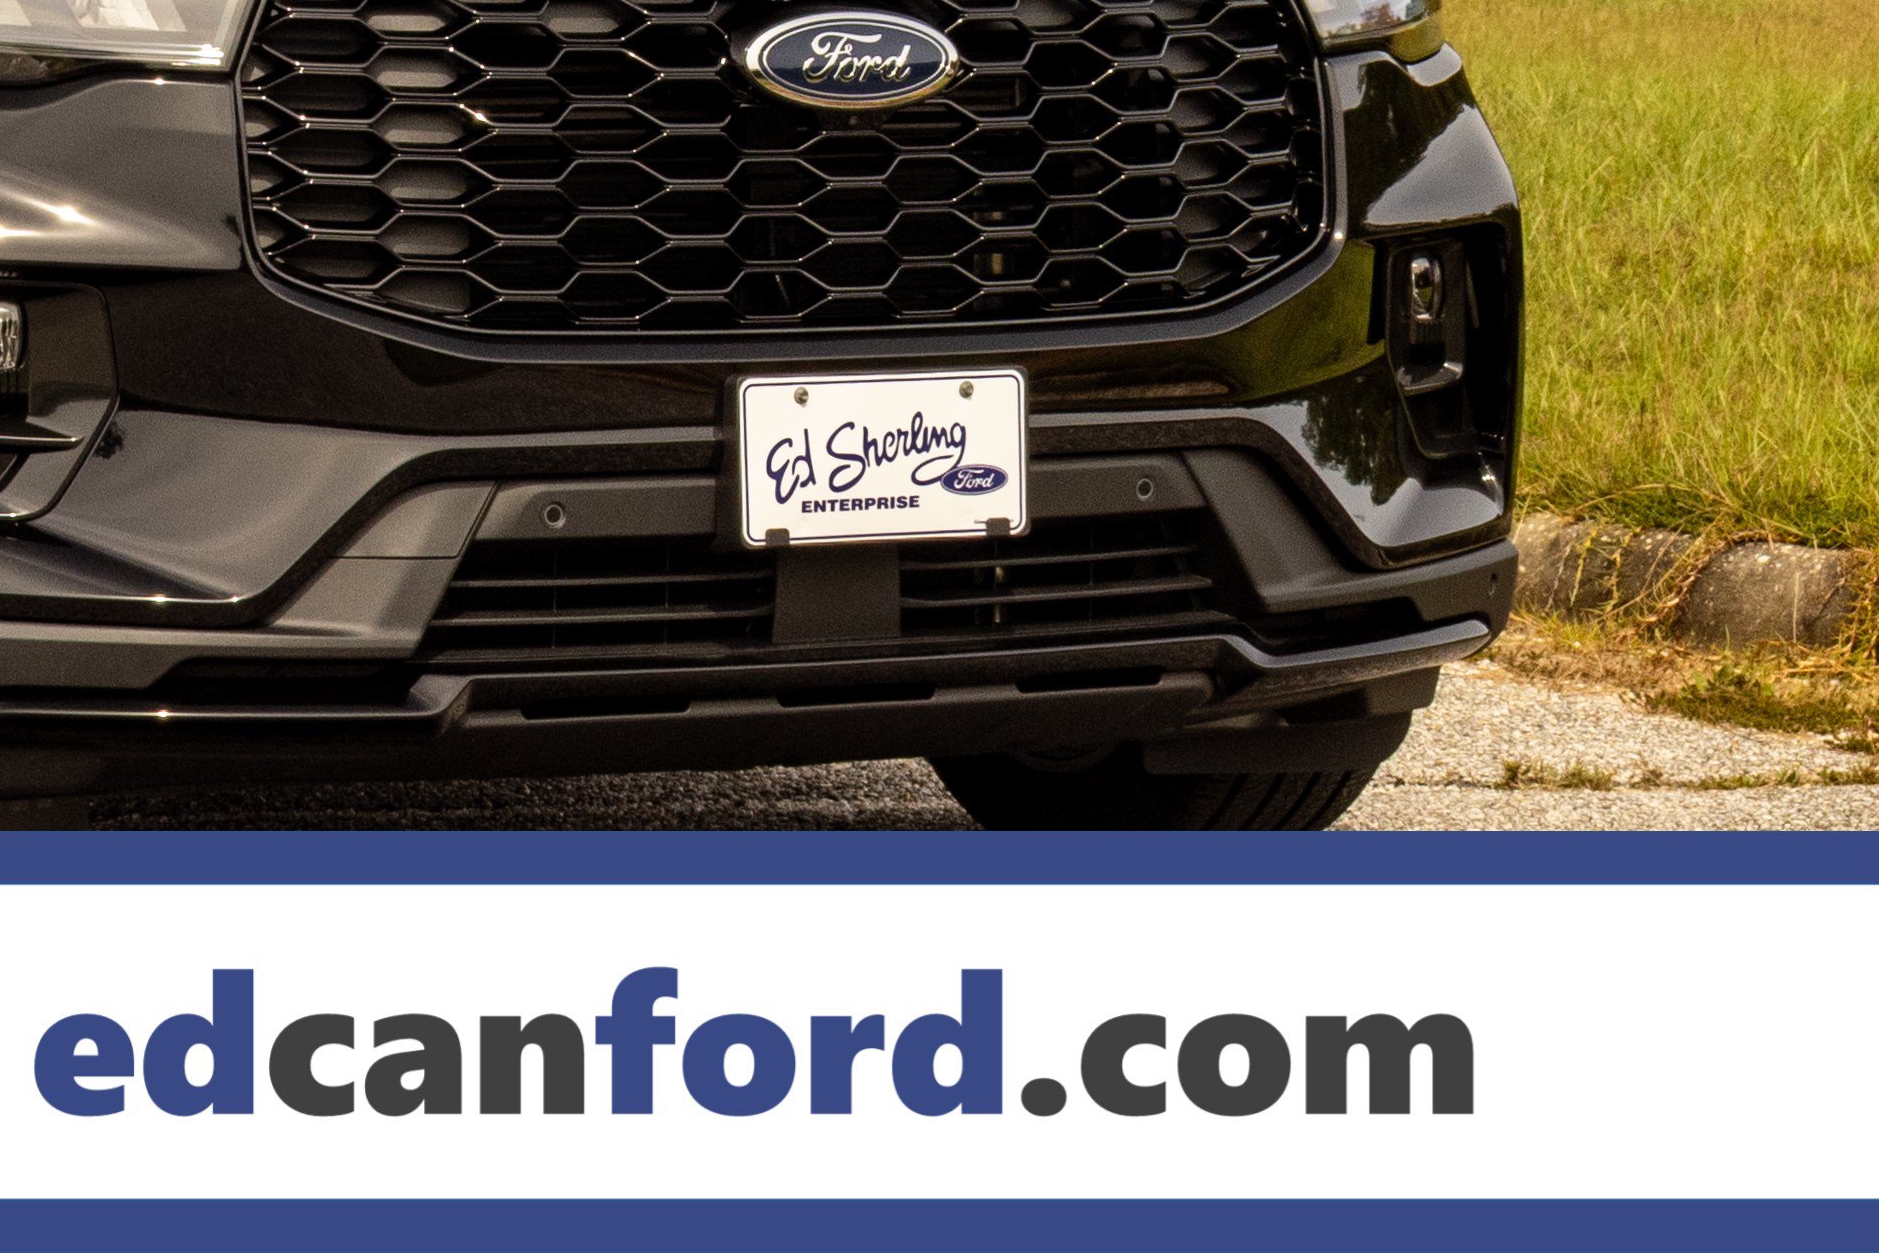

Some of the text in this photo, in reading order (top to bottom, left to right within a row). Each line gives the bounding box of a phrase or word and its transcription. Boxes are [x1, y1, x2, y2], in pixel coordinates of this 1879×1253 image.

[803, 32, 911, 84] Ford
[767, 411, 967, 505] Ed Sherling
[954, 469, 995, 489] Ford
[801, 495, 920, 514] ENTERPRISE
